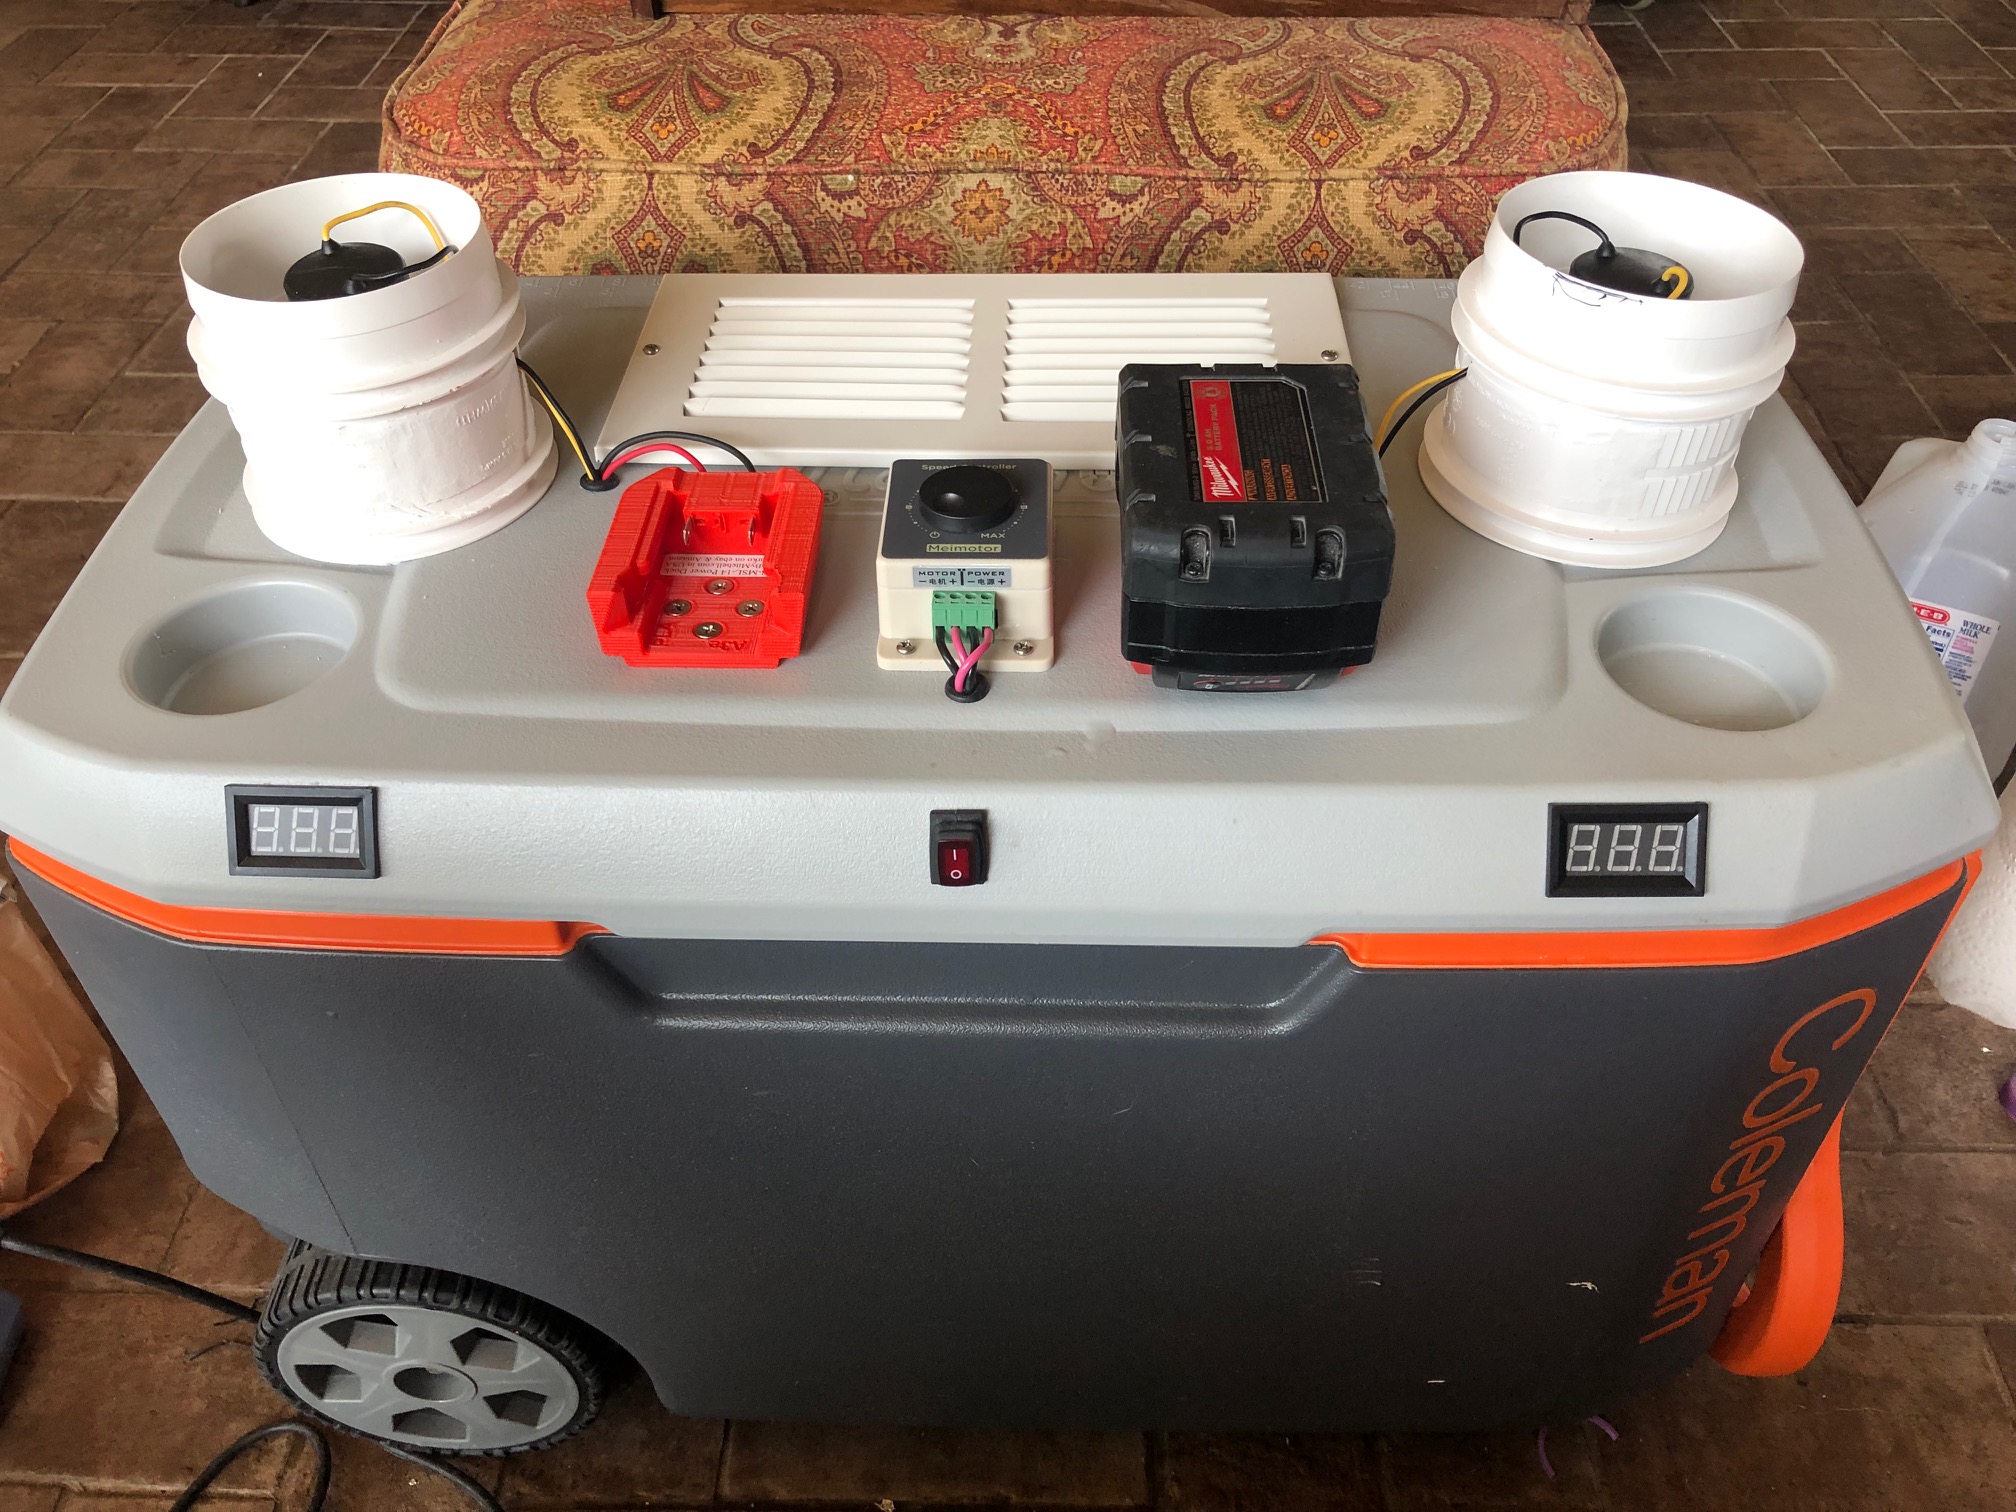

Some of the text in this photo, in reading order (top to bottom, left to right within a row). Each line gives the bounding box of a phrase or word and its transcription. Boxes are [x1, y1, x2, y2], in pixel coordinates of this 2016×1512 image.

[1210, 403, 1223, 451] BATTERY PACK
[1203, 456, 1235, 499] Milwaukee
[928, 544, 1000, 553] Meimotor
[1926, 625, 1952, 638] Facts
[1959, 627, 1981, 639] MILK
[1963, 620, 1992, 634] WHOLE
[1639, 987, 1876, 1344] Coleman
